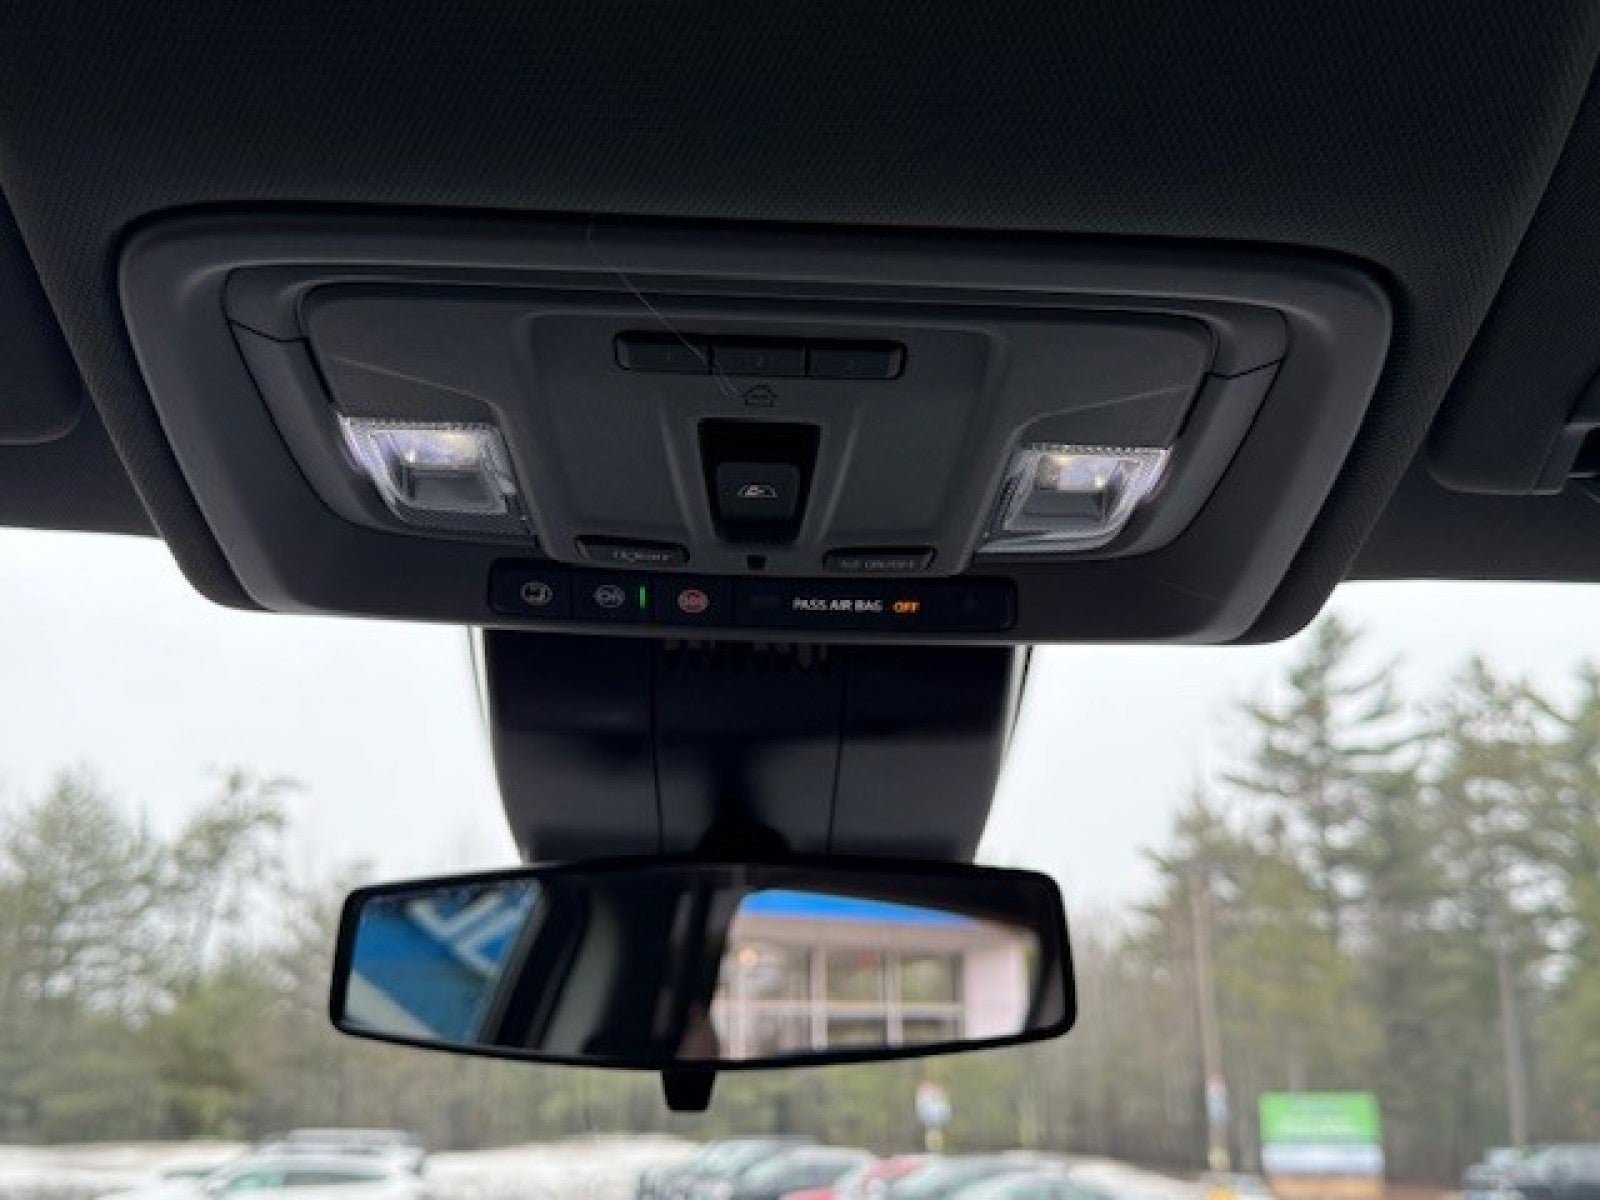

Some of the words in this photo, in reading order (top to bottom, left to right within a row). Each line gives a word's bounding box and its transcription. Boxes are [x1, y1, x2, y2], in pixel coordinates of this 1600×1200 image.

[792, 598, 828, 611] PASS
[830, 599, 851, 611] AIR
[854, 600, 883, 612] BAG
[893, 601, 920, 613] OFF
